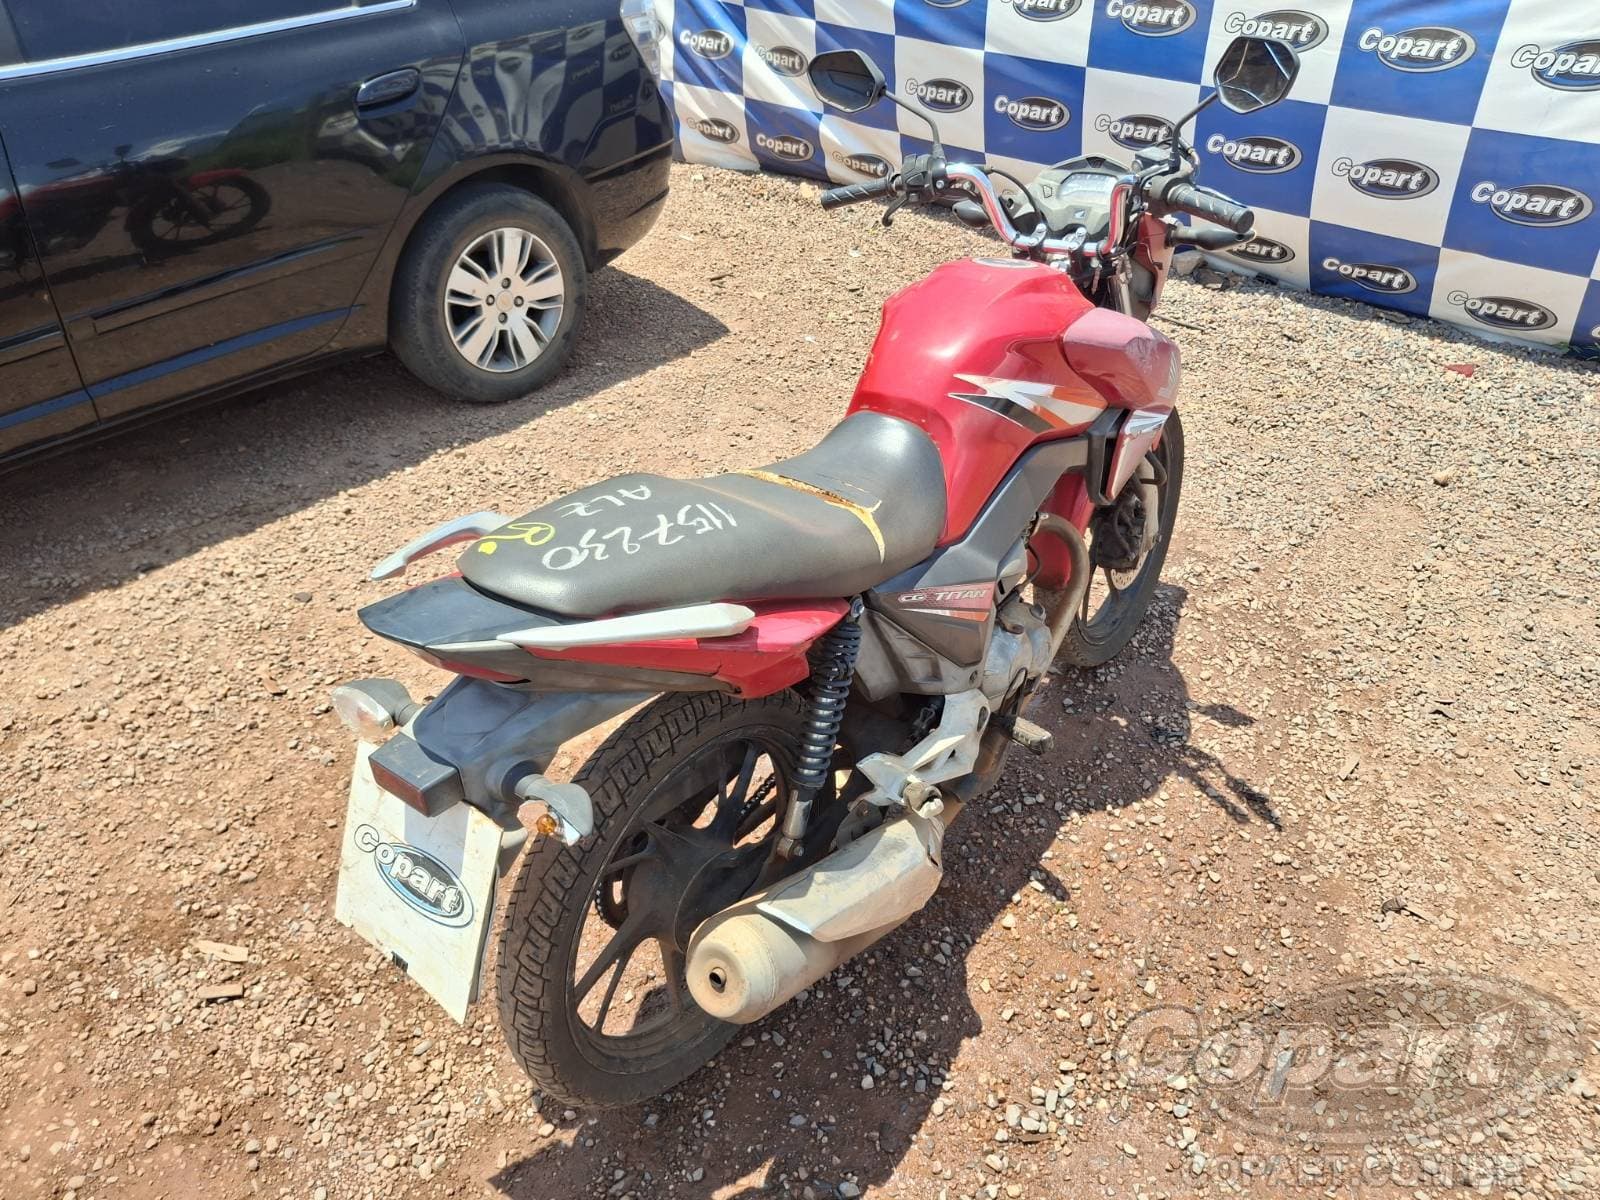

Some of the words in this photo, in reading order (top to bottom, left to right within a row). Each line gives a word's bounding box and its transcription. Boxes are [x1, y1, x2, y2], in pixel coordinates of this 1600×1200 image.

[1106, 0, 1187, 26] Copart
[1225, 12, 1314, 42] Copart
[680, 30, 726, 52] Copart
[1358, 28, 1464, 61] Copart
[756, 45, 801, 70] Copart
[1511, 44, 1600, 78] Copa
[904, 78, 963, 105] Copart
[994, 95, 1061, 123] Copart
[687, 117, 732, 139] Copart
[1095, 114, 1168, 143] Copart
[756, 133, 806, 156] Copart
[1206, 133, 1291, 168] Copart
[832, 151, 885, 177] Copart
[1331, 157, 1427, 192] Copart
[1471, 181, 1580, 219] Copart
[1232, 243, 1281, 258] part
[1322, 257, 1407, 290] Copart
[1447, 290, 1543, 326] Copart
[935, 589, 988, 601] TITAN
[354, 824, 463, 913] Copart
